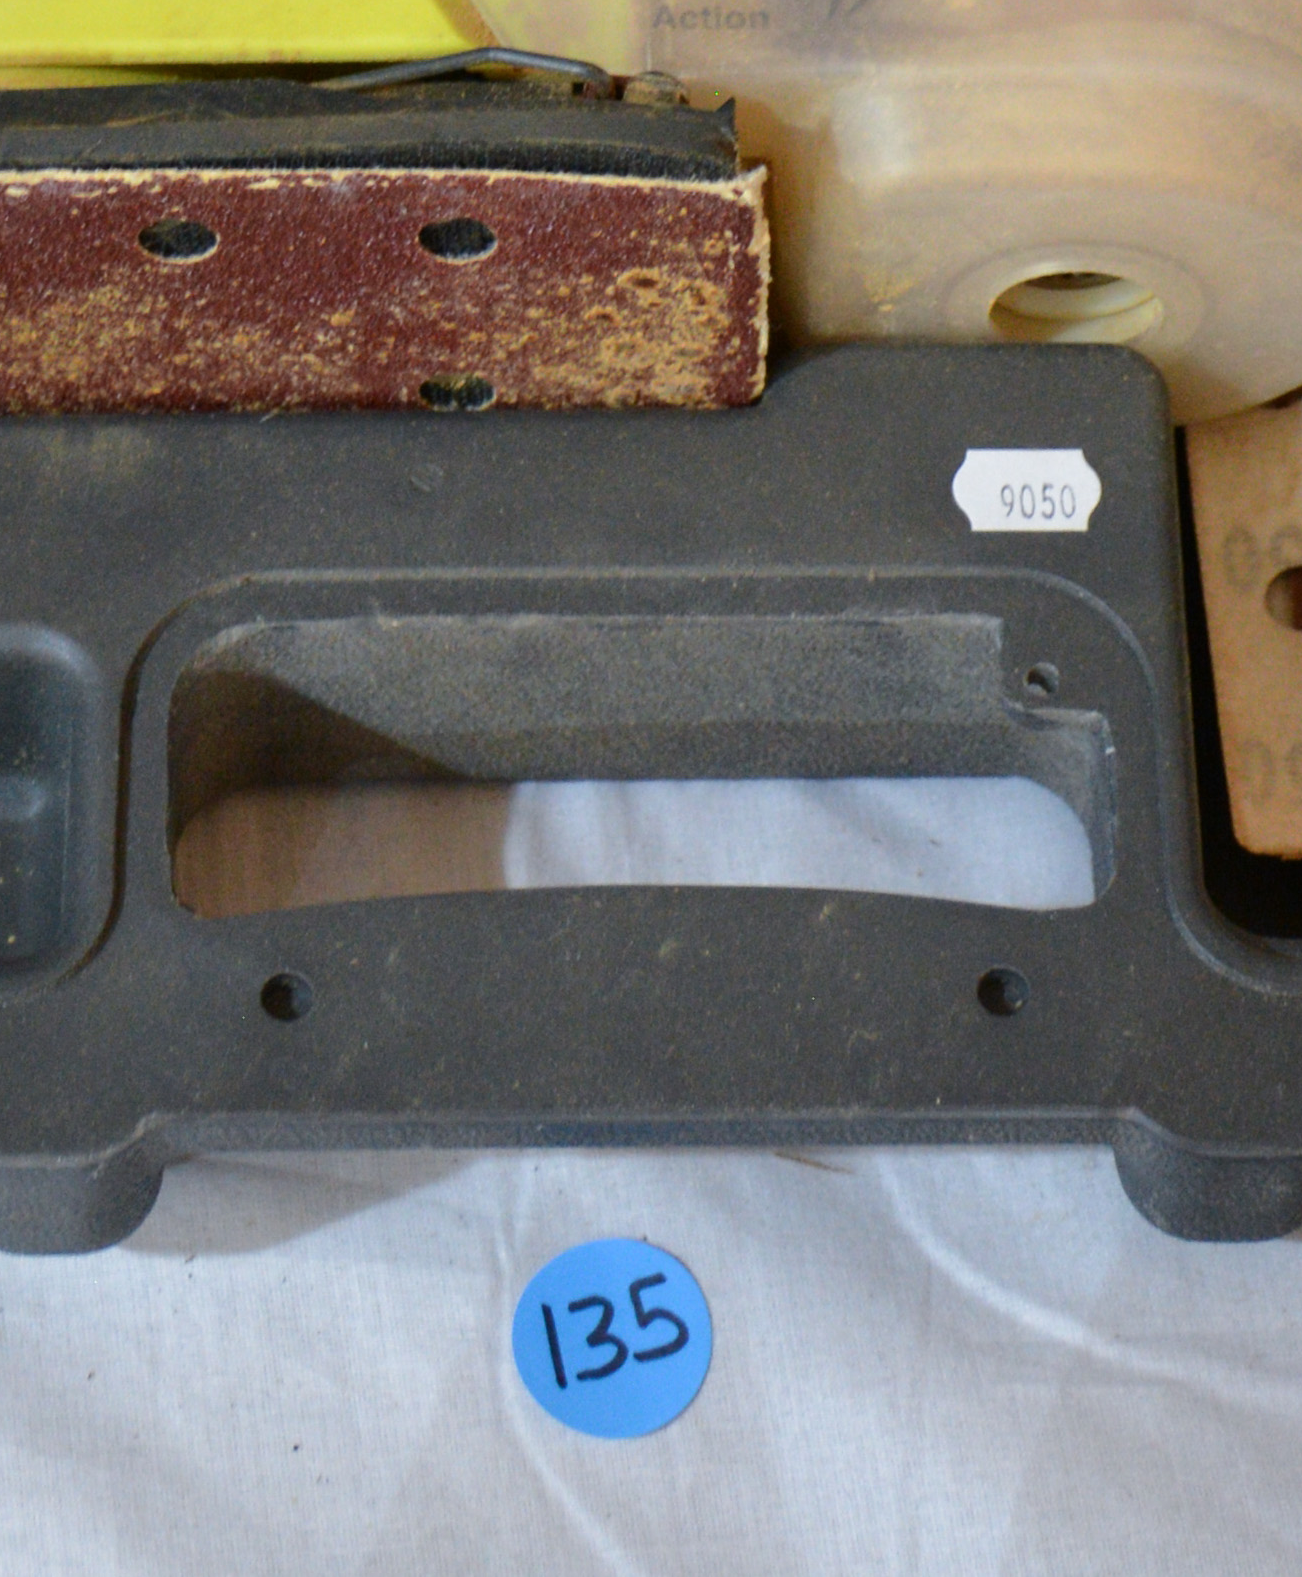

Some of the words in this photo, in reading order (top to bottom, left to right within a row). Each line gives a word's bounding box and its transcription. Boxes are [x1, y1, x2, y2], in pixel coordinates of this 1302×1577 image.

[652, 5, 770, 31] Action
[1000, 483, 1077, 520] 9050
[540, 1272, 690, 1389] 135
